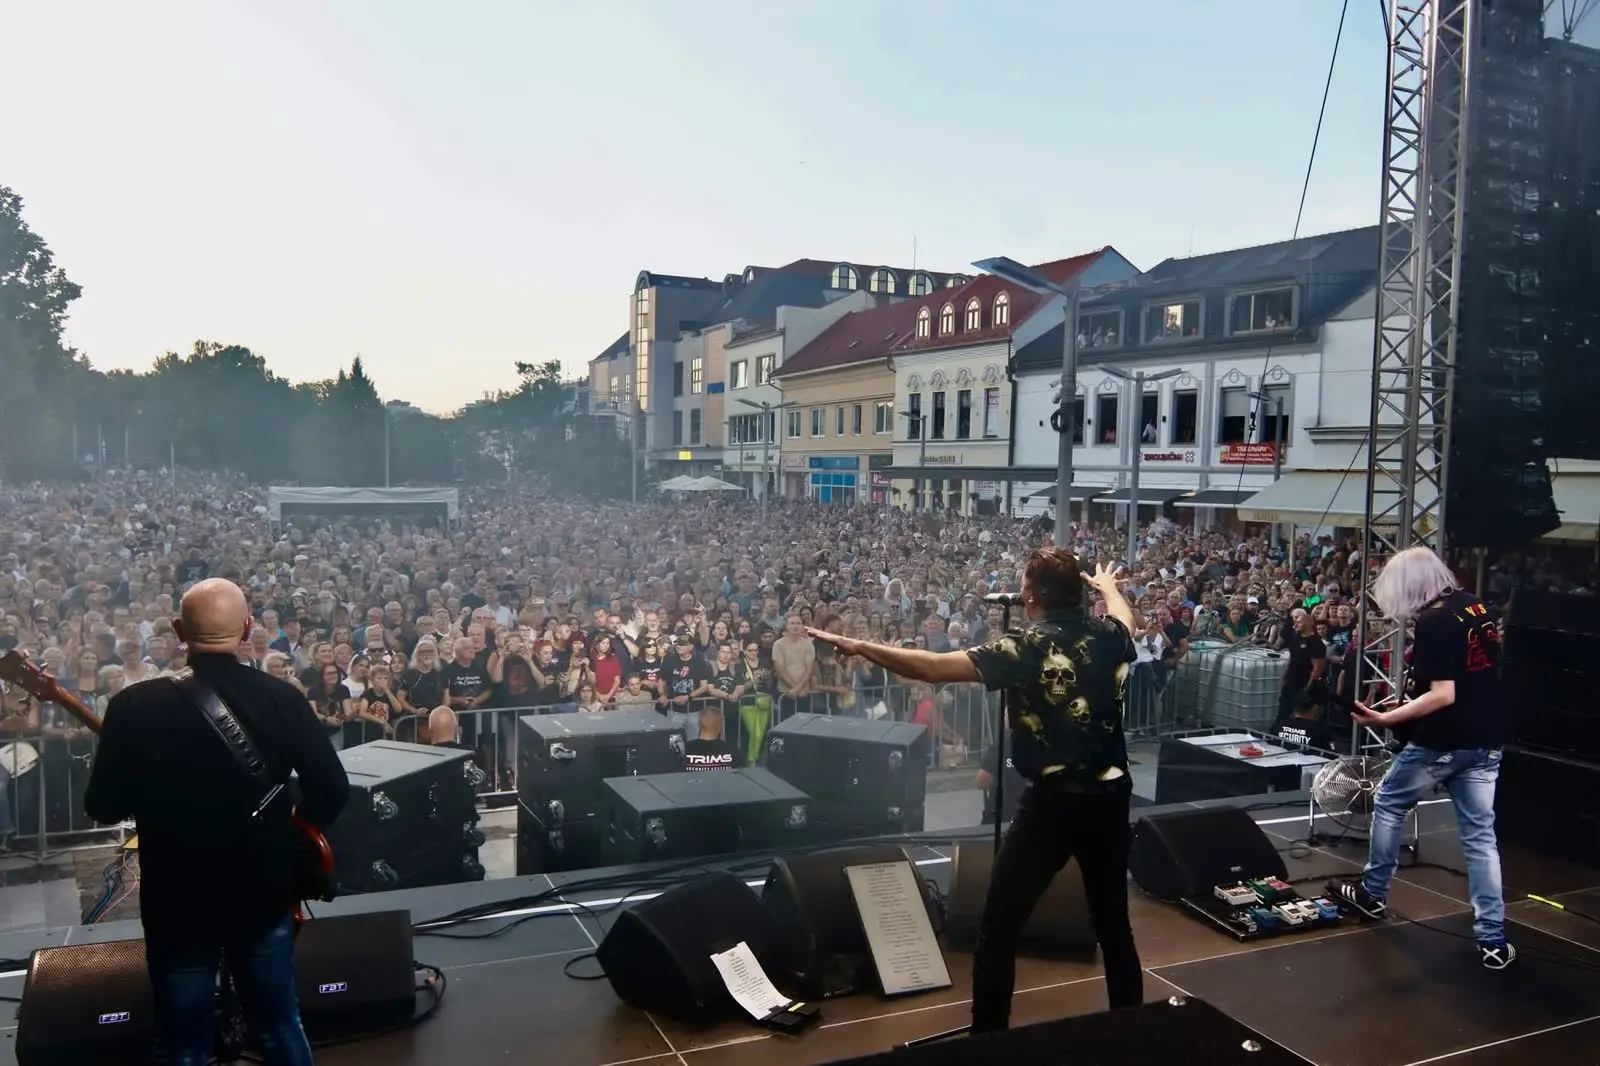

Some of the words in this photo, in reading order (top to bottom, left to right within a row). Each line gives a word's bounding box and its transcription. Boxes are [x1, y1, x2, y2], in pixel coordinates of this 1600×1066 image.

[1282, 726, 1306, 735] TRIMS
[686, 754, 732, 763] TRIMS
[321, 983, 347, 992] FBT
